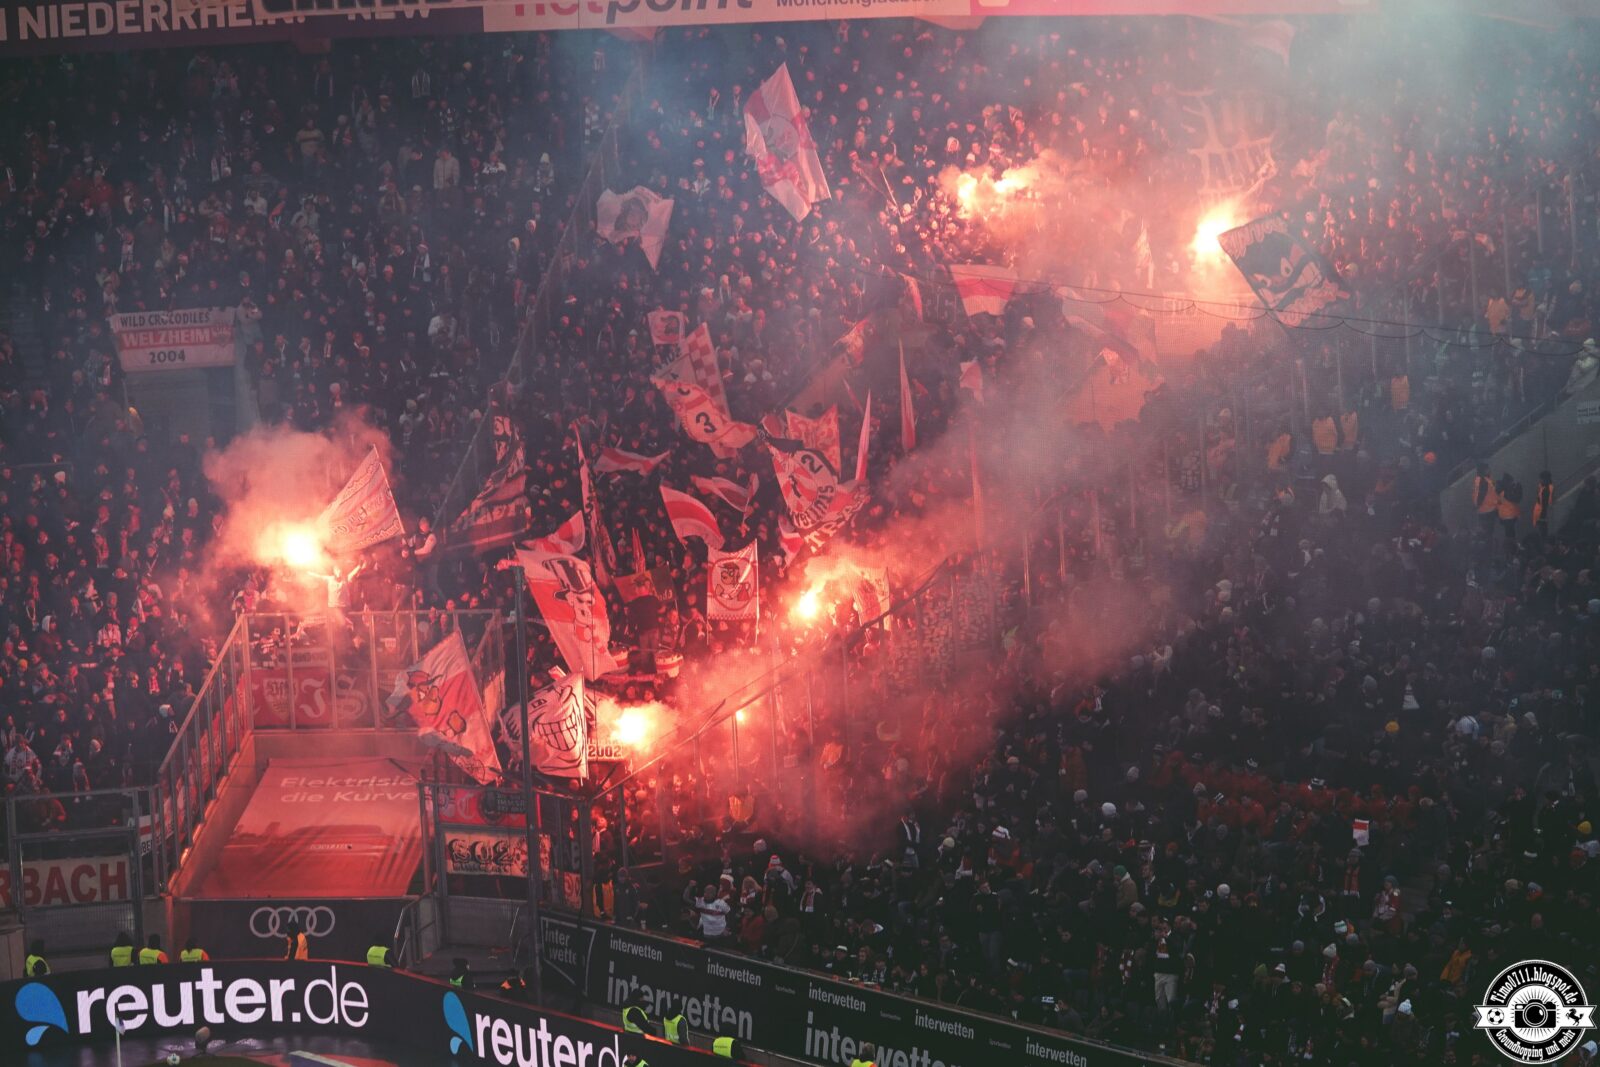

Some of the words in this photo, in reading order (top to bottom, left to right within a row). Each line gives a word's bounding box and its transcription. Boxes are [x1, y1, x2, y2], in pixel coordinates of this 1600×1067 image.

[18, 0, 306, 40] NIEDERRHE.
[120, 315, 146, 328] WILD
[122, 328, 210, 347] WELZHEIM
[149, 350, 186, 364] 2004
[610, 933, 663, 961] interwetten
[707, 958, 762, 986] interwetten
[76, 965, 369, 1034] reuter.de
[808, 982, 866, 1012] interwetten
[915, 1009, 974, 1040] interwetten
[1025, 1036, 1087, 1067] interwetten
